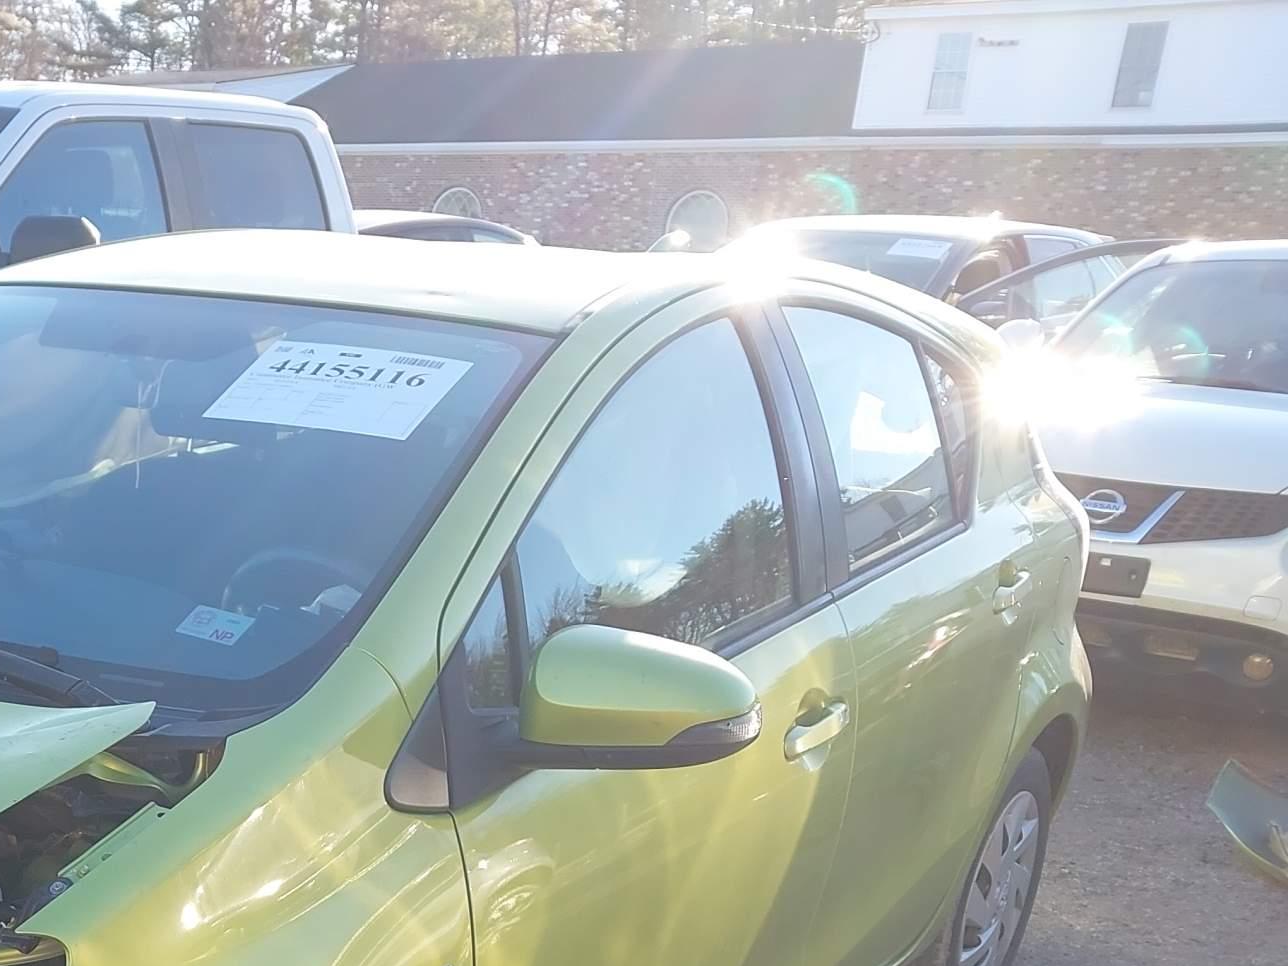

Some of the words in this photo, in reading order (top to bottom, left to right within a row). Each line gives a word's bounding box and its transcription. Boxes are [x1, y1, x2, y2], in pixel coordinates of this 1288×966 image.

[269, 358, 431, 388] 44155116
[1082, 501, 1121, 511] NISSAN
[209, 629, 234, 641] NP
